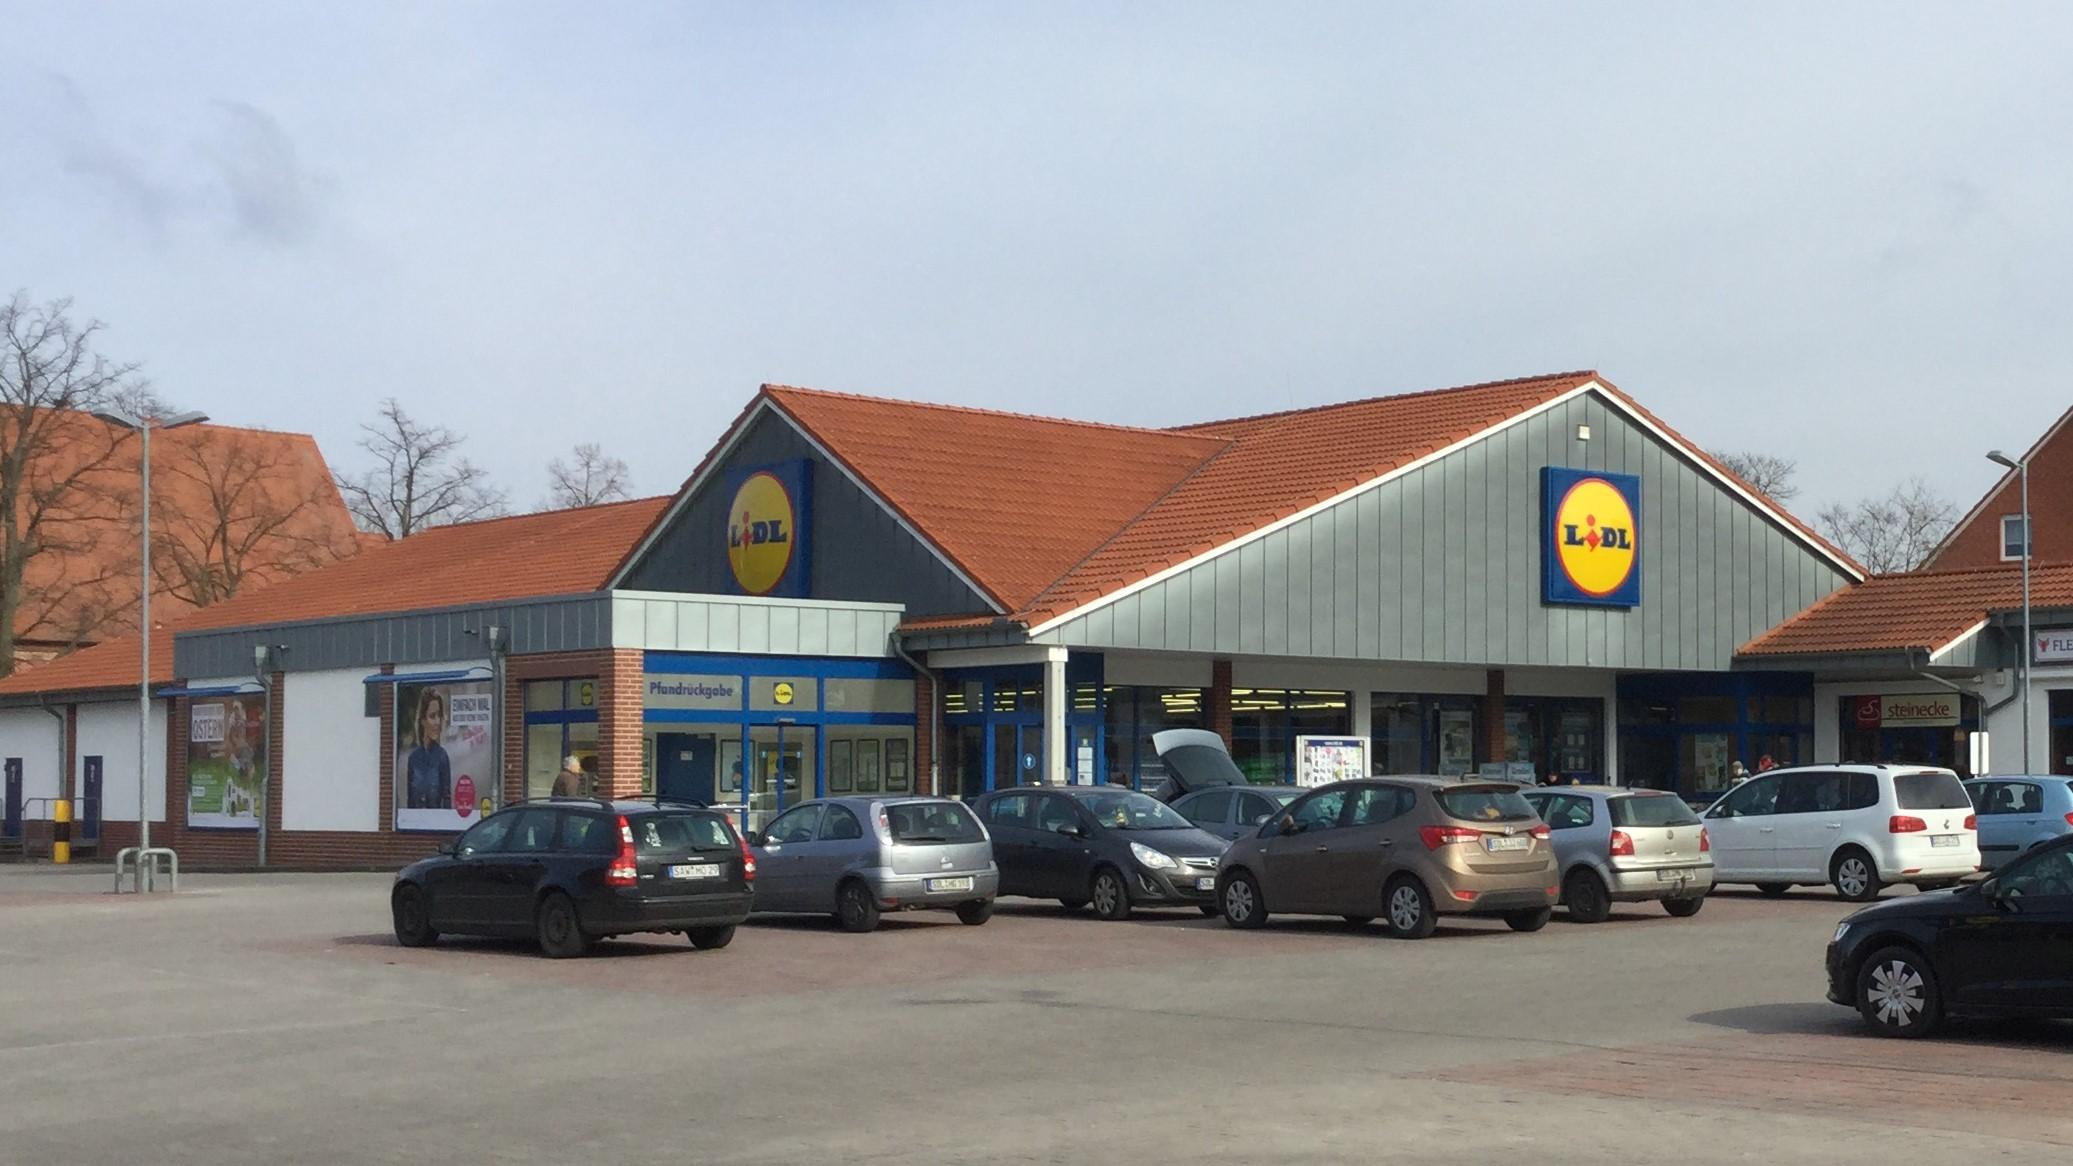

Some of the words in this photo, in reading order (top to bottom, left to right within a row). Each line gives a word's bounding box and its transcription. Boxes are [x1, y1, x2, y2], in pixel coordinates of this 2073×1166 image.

[731, 511, 787, 550] LIDL
[1564, 514, 1631, 552] LIDL
[649, 681, 733, 699] Pfandrückgabe
[1887, 701, 1950, 717] steinecke
[193, 719, 224, 739] OSTERN
